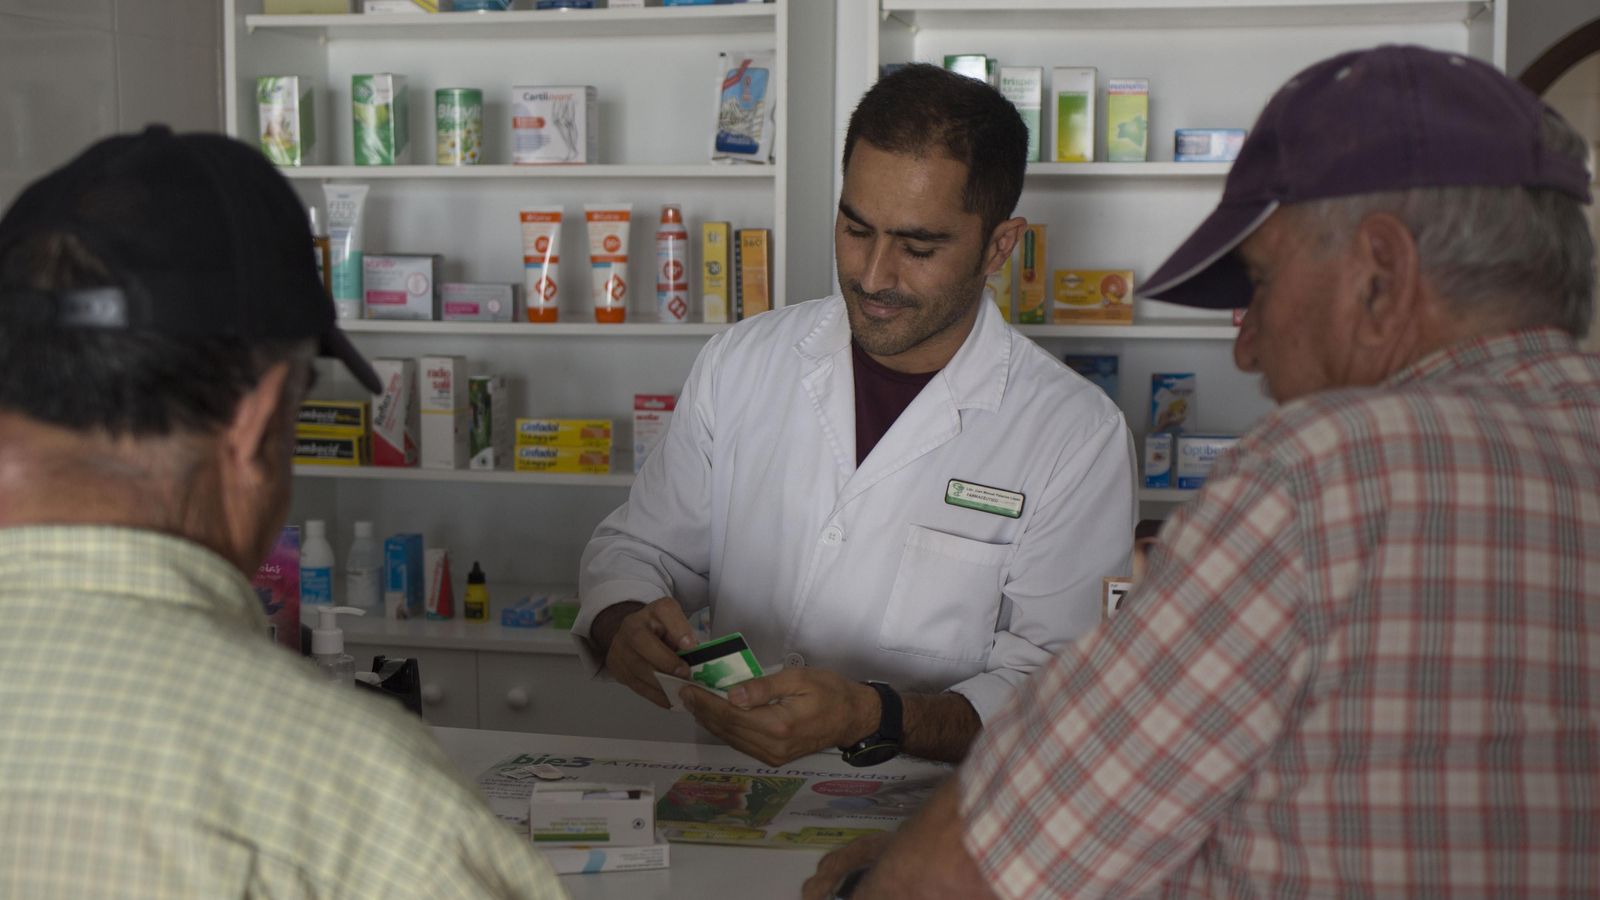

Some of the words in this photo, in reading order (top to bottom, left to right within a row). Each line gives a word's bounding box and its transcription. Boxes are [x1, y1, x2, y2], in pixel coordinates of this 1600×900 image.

[520, 422, 560, 432] Cinfadol
[519, 447, 559, 457] Cinfadol
[511, 752, 595, 769] bie3
[626, 760, 706, 771] medida
[720, 765, 750, 775] de
[756, 766, 780, 776] tu
[787, 769, 908, 781] necesidad
